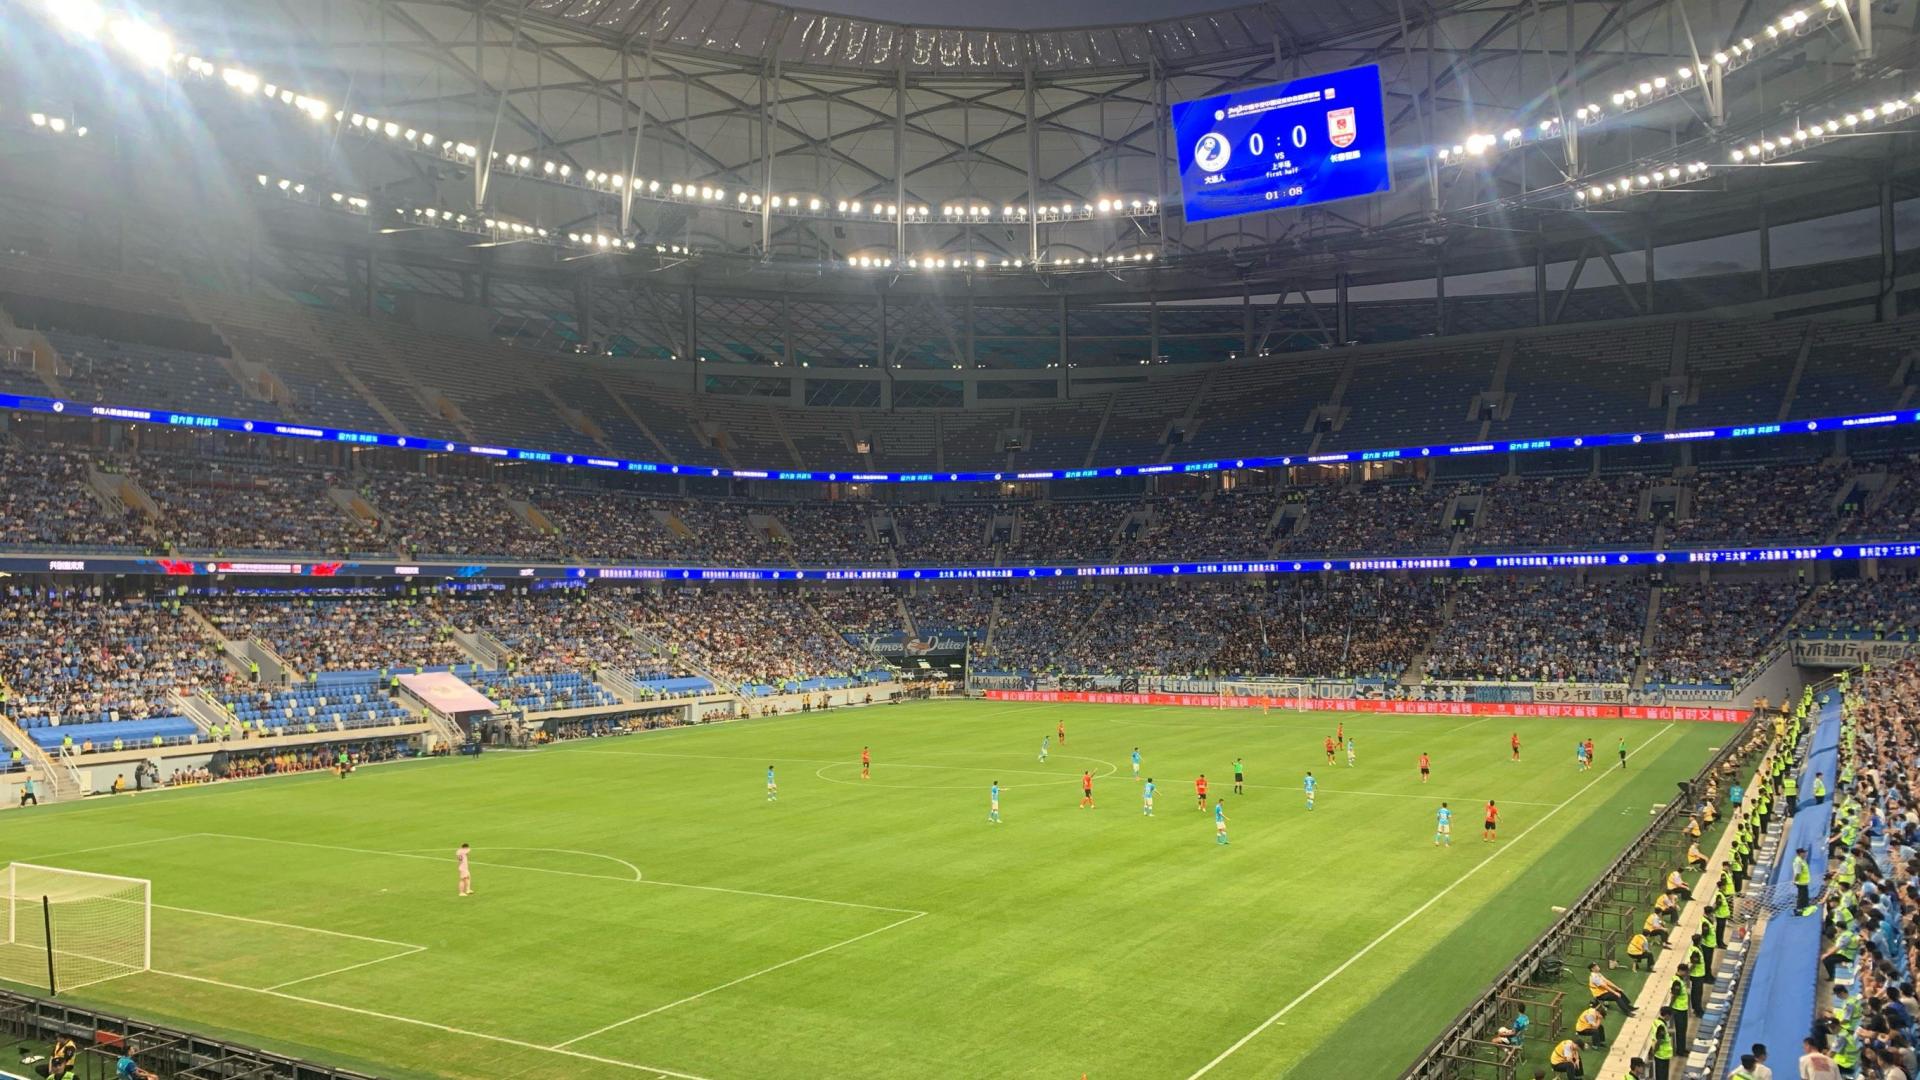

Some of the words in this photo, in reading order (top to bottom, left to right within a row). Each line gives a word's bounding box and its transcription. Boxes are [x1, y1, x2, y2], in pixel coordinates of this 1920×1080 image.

[1249, 133, 1264, 156] 0
[1292, 125, 1307, 148] 0
[1274, 152, 1285, 160] VS
[1272, 160, 1292, 170] 上半场
[1204, 173, 1226, 185] 大连人
[1265, 191, 1279, 200] 01
[1288, 186, 1303, 197] 08
[1309, 683, 1356, 699] NORD
[1536, 690, 1555, 701] 39
